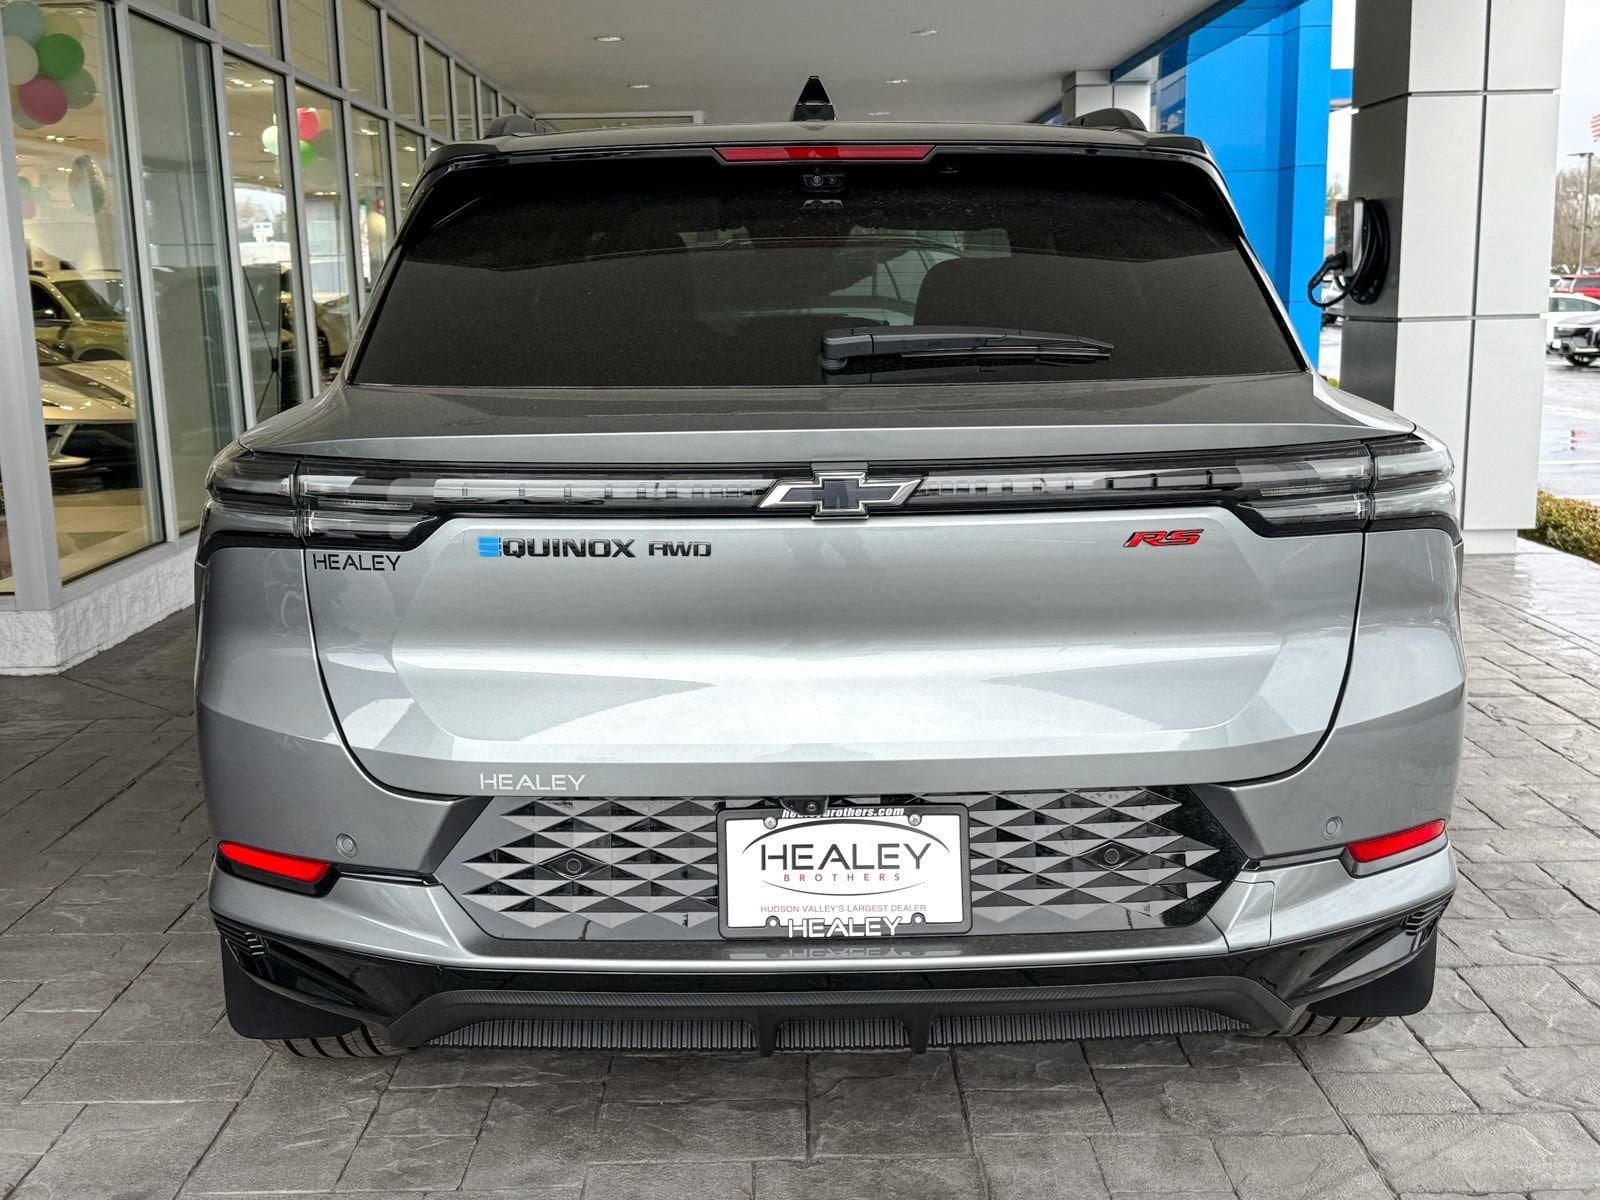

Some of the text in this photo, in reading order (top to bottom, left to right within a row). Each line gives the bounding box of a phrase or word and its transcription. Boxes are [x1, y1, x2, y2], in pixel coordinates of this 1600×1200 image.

[478, 536, 712, 557] EQUINOX AWD
[1123, 529, 1204, 547] RS
[312, 553, 401, 571] HEALEY
[480, 773, 586, 791] HEALEY
[761, 843, 931, 870] HEALEY
[783, 873, 900, 882] BROTHERS
[760, 904, 927, 913] HUDSON VALLEY'S LARGEST DEALER
[788, 916, 902, 938] HEALEY
